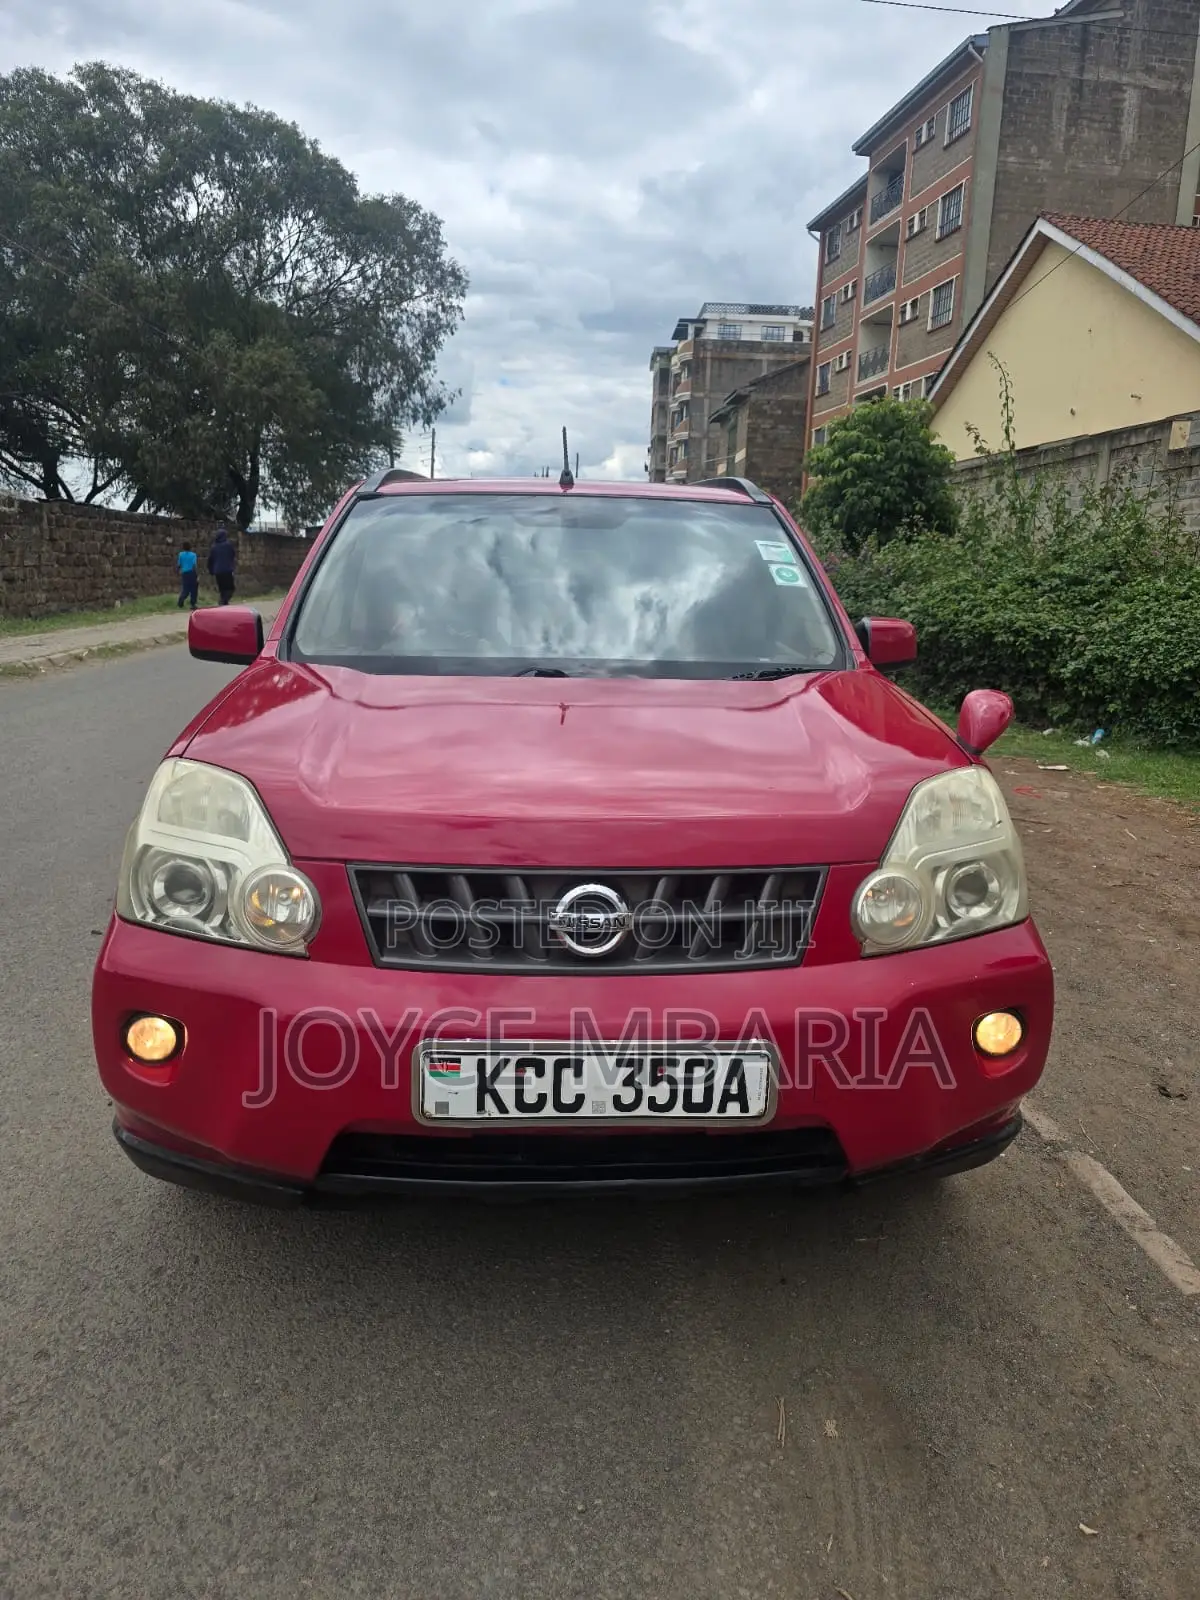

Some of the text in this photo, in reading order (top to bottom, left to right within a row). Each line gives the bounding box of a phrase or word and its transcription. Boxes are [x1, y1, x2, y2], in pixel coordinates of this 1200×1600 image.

[558, 915, 626, 929] NISSAN
[477, 1057, 586, 1114] KCC
[612, 1057, 750, 1114] 350A
